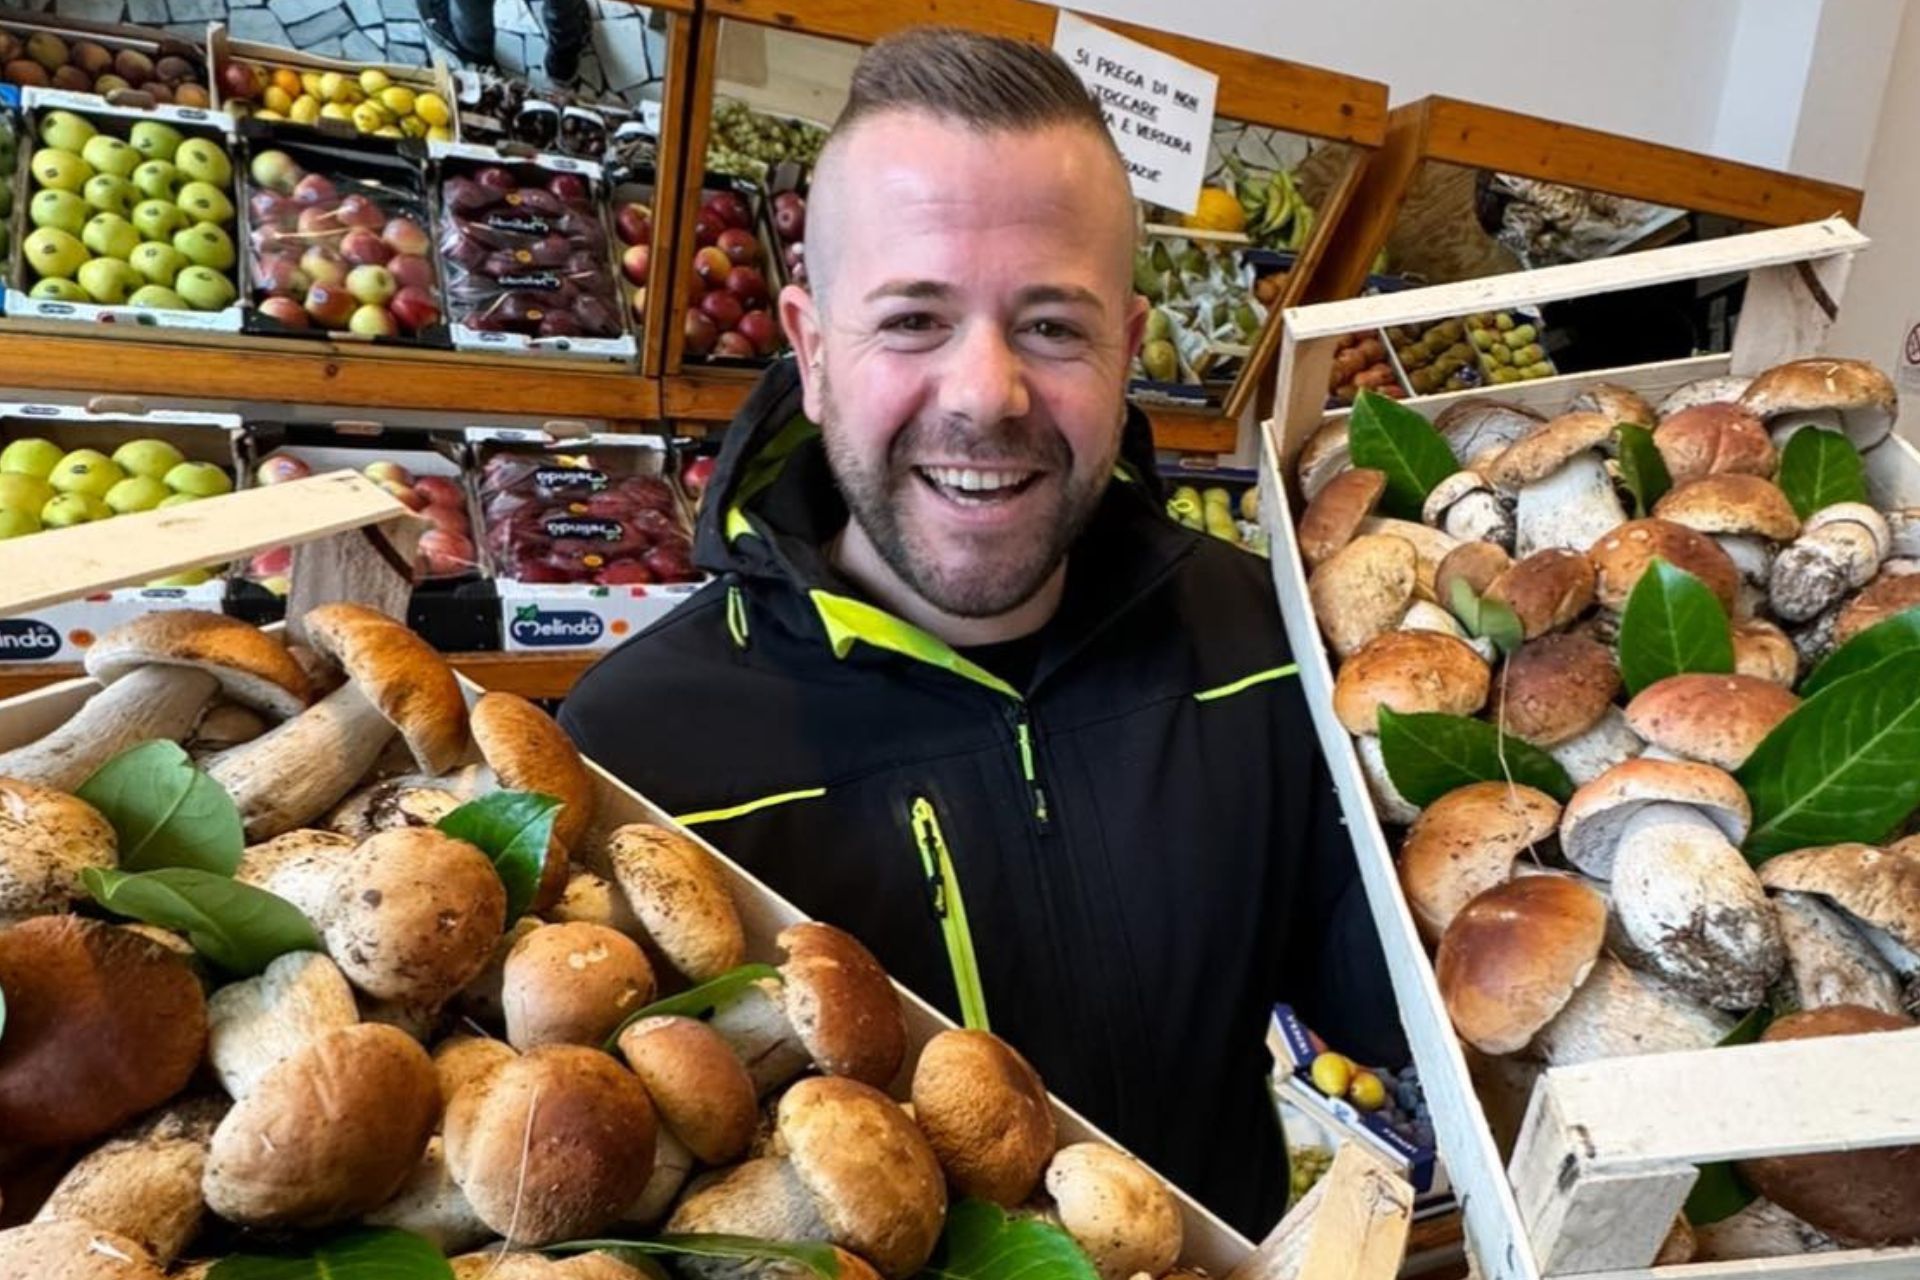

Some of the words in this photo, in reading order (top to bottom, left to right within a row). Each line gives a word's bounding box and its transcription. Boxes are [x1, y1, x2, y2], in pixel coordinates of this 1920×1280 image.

[1074, 48, 1089, 66] SI
[1096, 56, 1144, 88] PREGA
[1153, 80, 1168, 96] DI
[1174, 90, 1199, 110] NON
[1094, 84, 1160, 117] TOCCARE
[1121, 117, 1131, 134] E
[513, 617, 600, 638] Melinda
